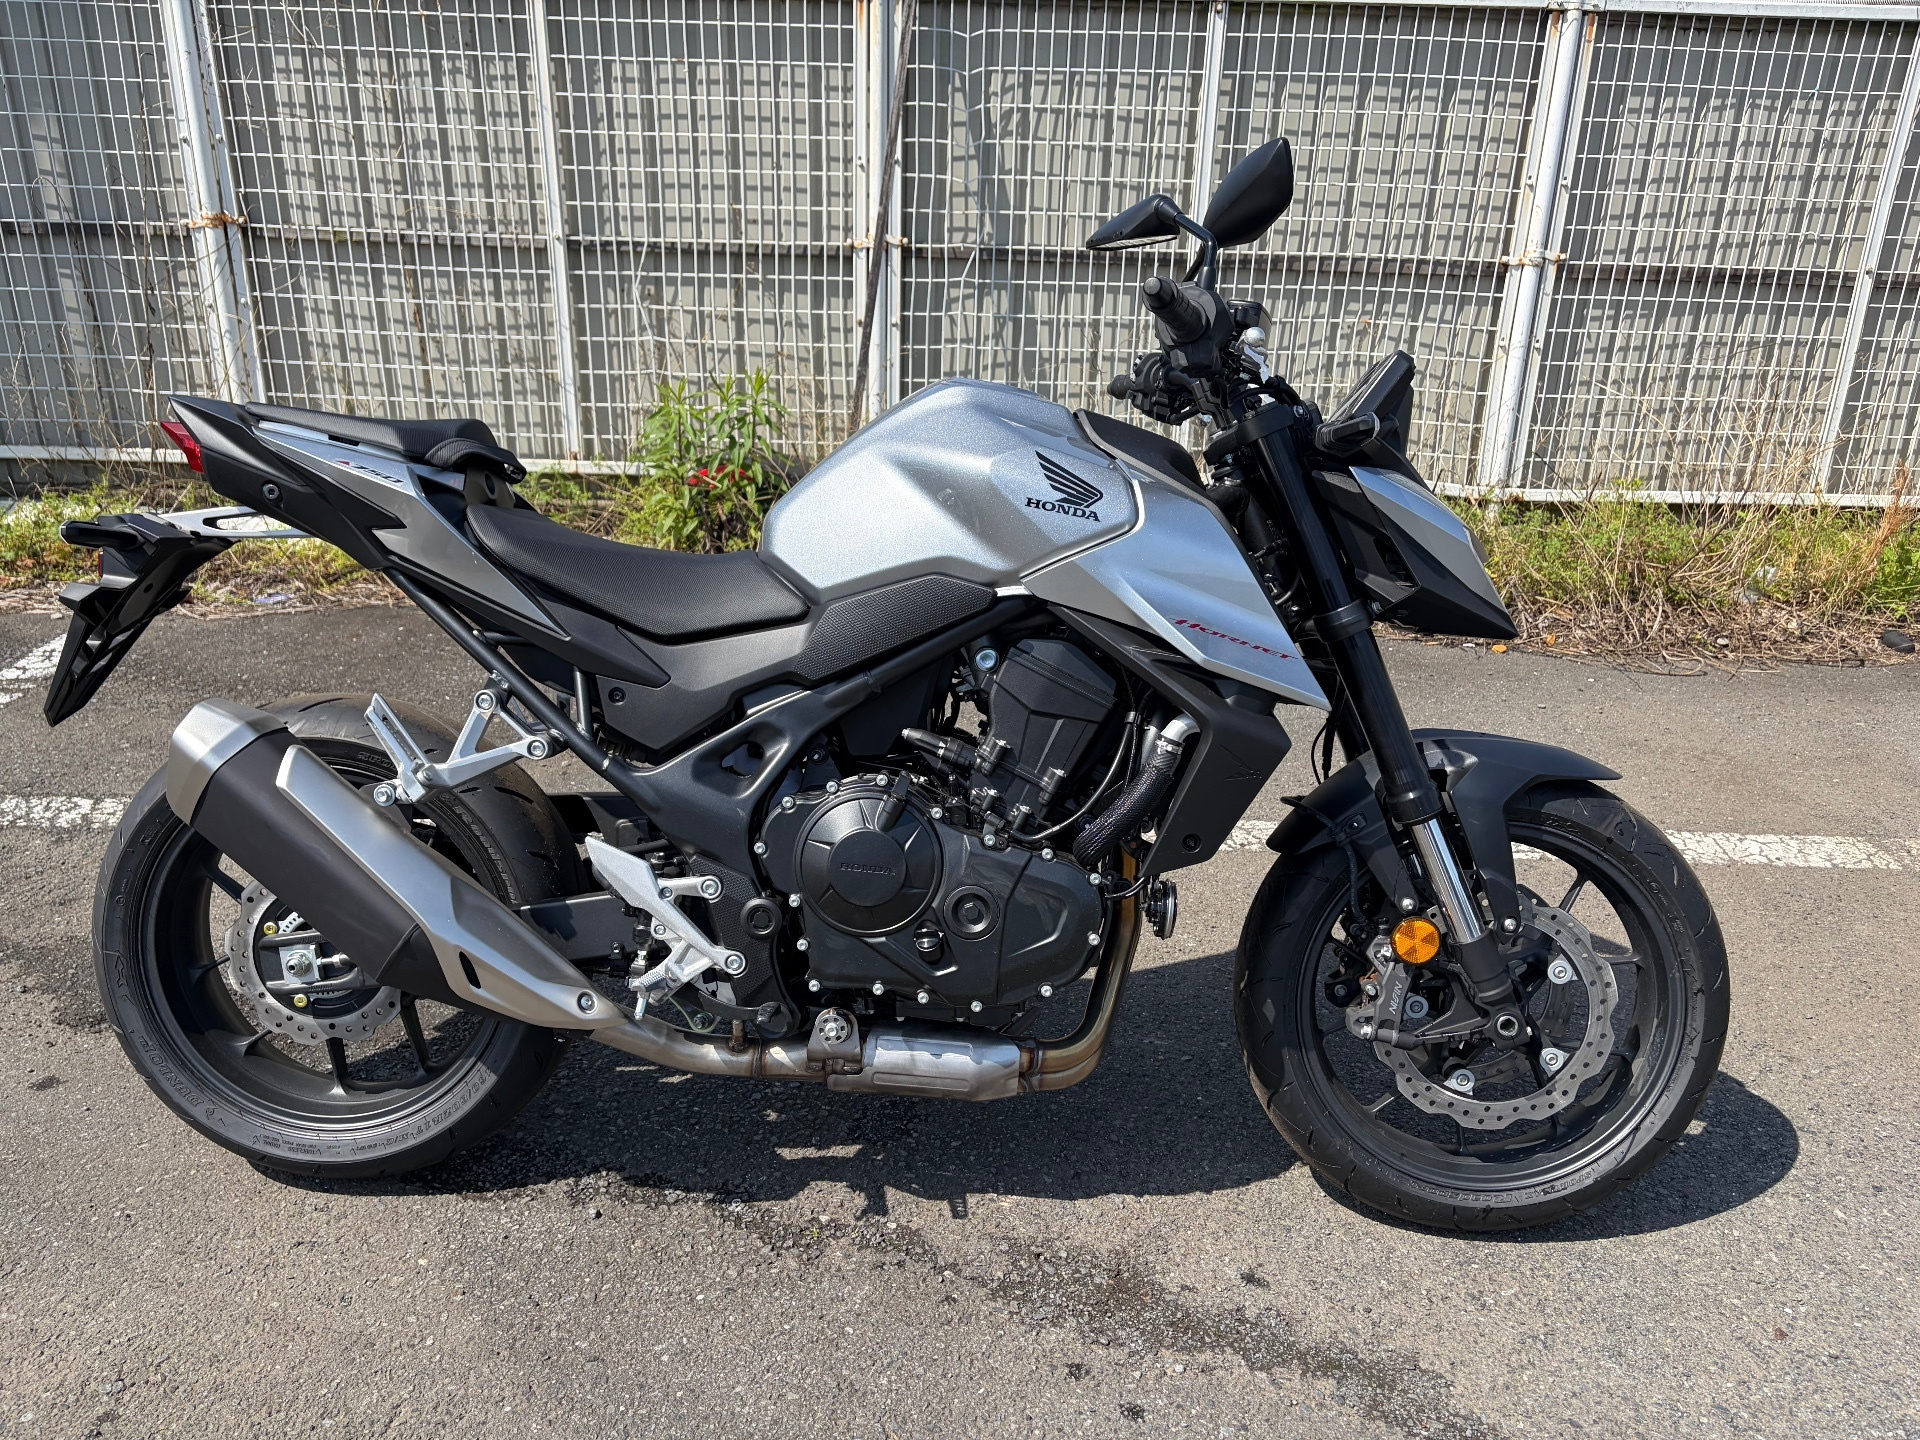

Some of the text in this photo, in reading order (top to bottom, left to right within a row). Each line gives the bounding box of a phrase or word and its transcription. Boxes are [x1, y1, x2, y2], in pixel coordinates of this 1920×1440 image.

[1025, 497, 1101, 523] HONDA
[839, 862, 896, 876] HONDA
[1388, 980, 1403, 1015] NISSIN
[138, 1035, 204, 1108] DUNLOP
